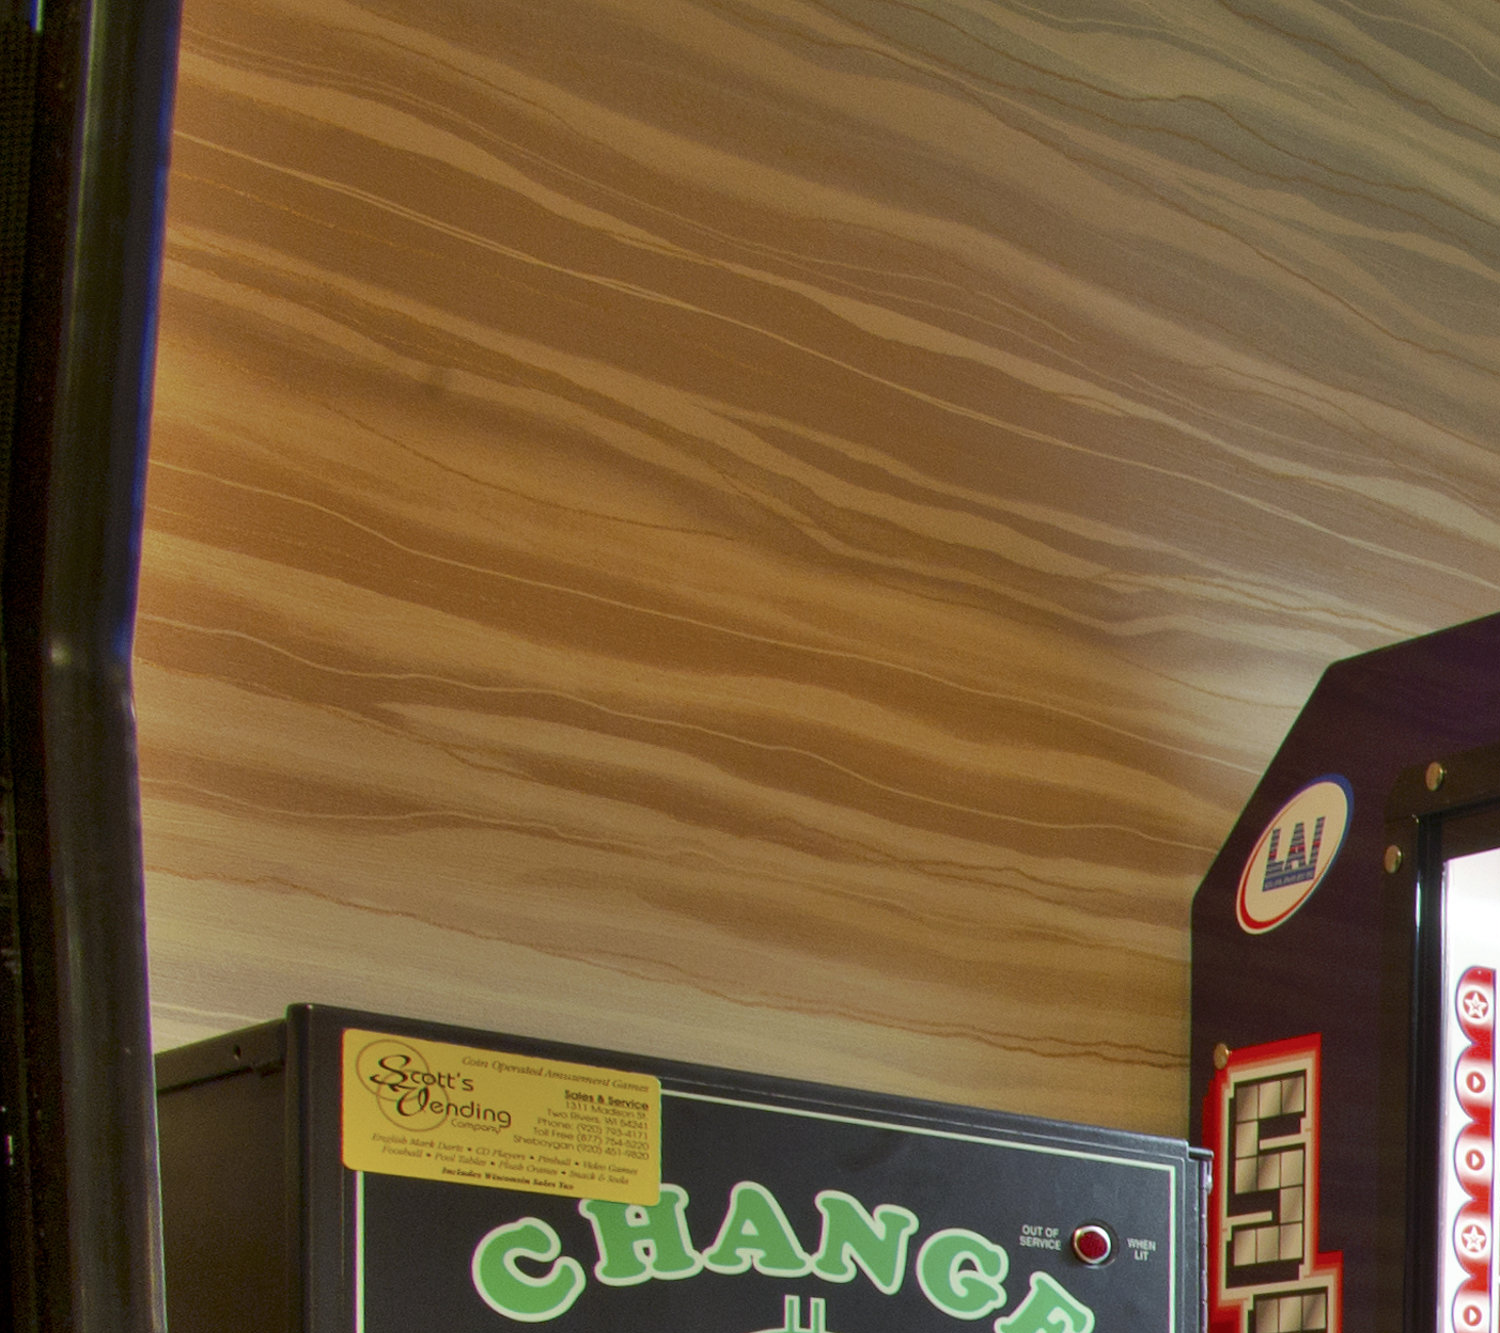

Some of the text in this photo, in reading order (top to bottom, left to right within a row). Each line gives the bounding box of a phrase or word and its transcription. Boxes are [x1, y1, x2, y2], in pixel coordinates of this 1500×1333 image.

[369, 1054, 475, 1092] Scott's
[388, 1083, 512, 1129] Vending
[565, 1089, 649, 1111] Sales Service
[1021, 1224, 1059, 1238] OUT OF
[1019, 1235, 1062, 1251] SERVICE
[1127, 1237, 1157, 1252] WHEN
[1134, 1249, 1149, 1261] LIT
